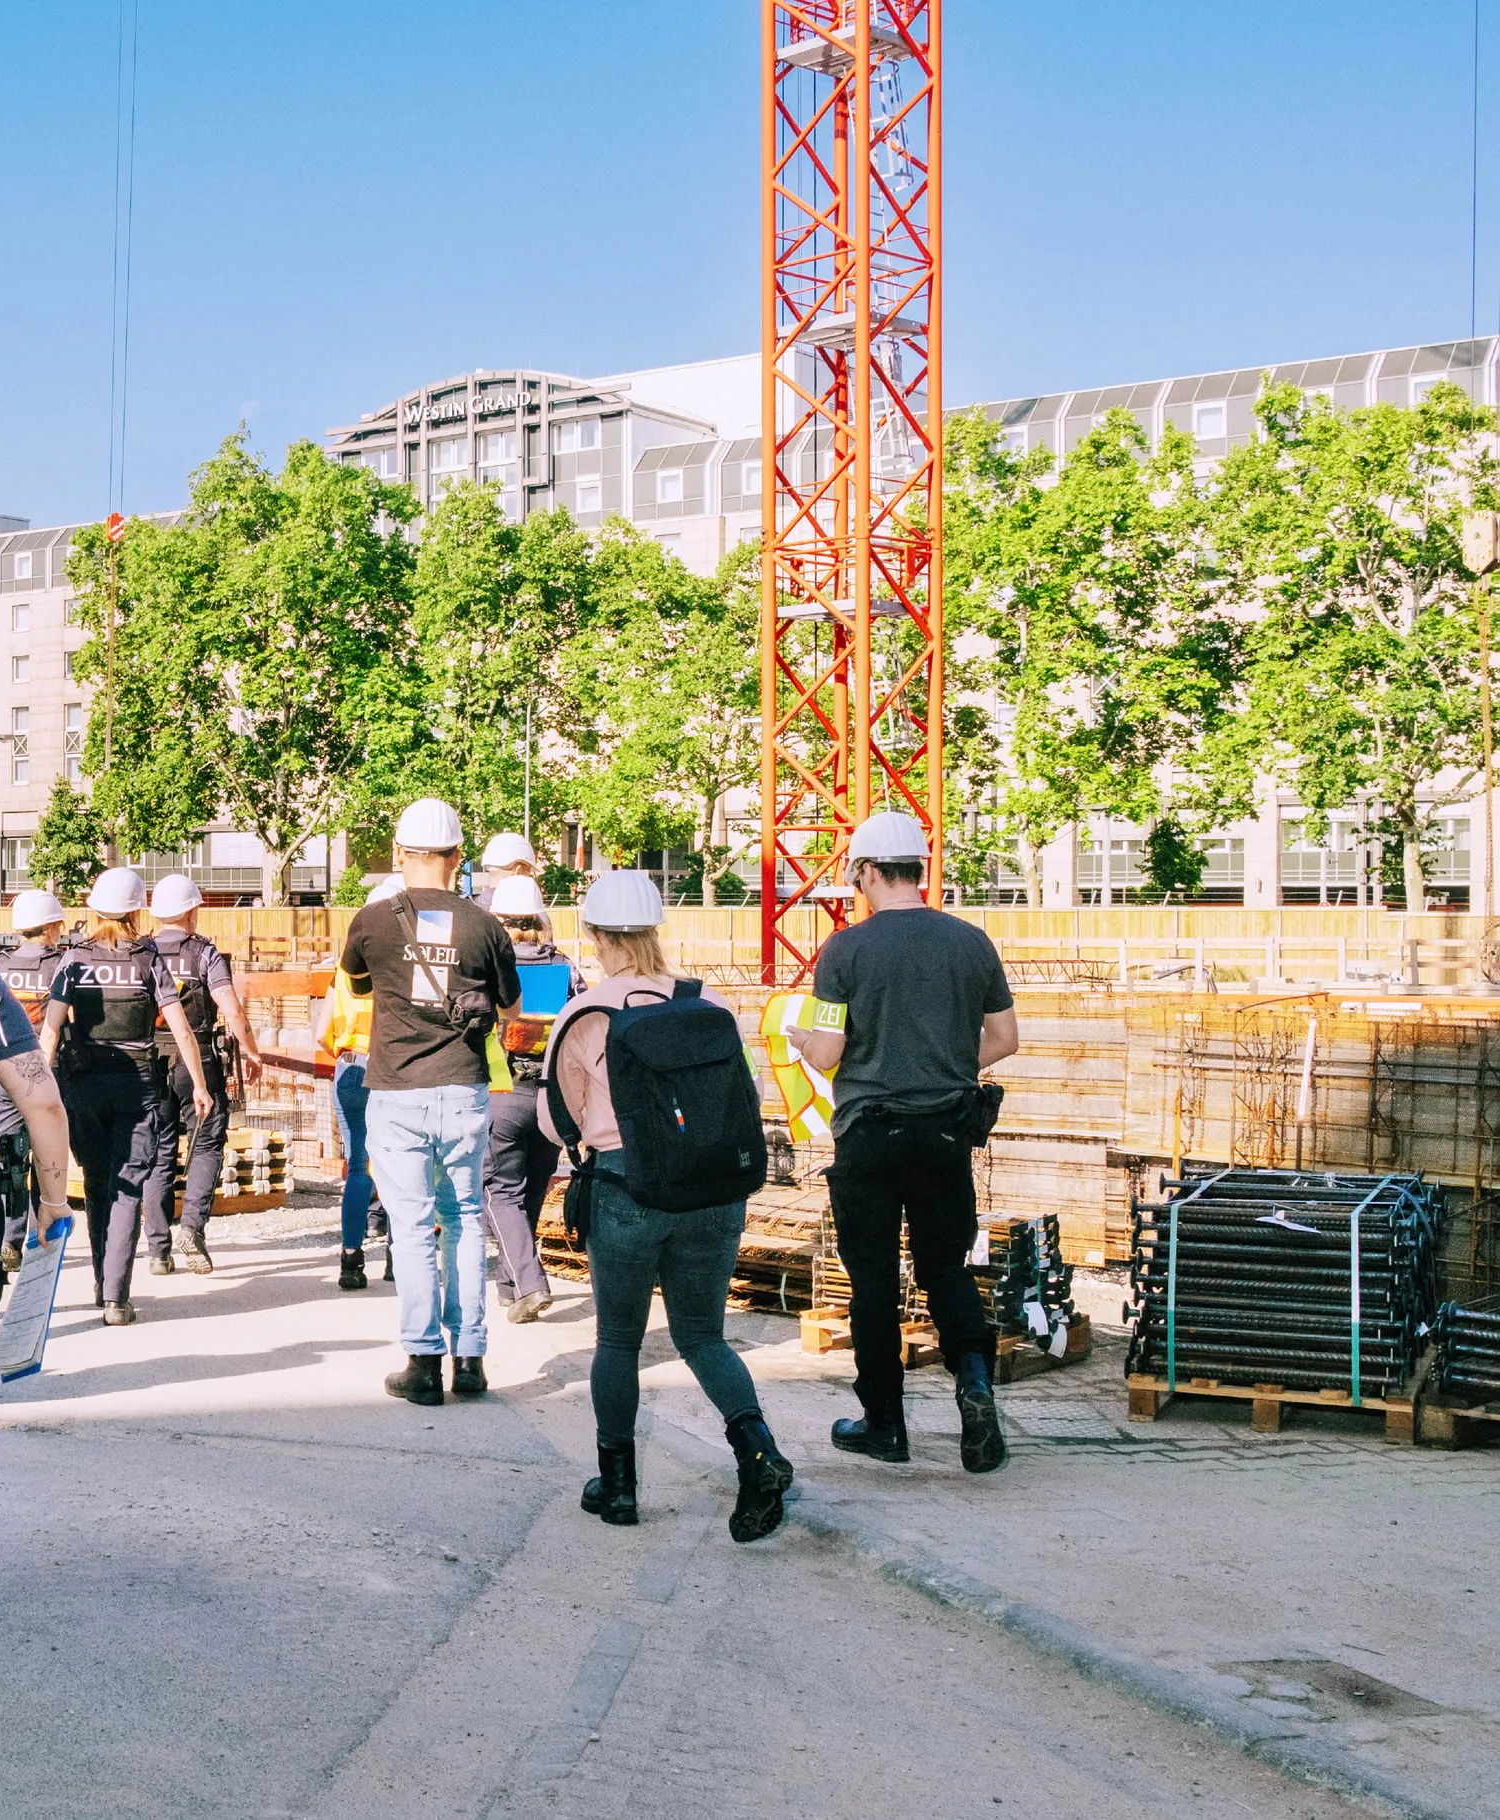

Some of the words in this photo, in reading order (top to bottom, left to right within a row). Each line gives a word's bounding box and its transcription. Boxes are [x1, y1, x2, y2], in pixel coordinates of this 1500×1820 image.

[404, 402, 465, 424] WESTIN
[469, 391, 531, 414] GRAND
[79, 965, 143, 985] ZOLL
[167, 958, 191, 975] LL
